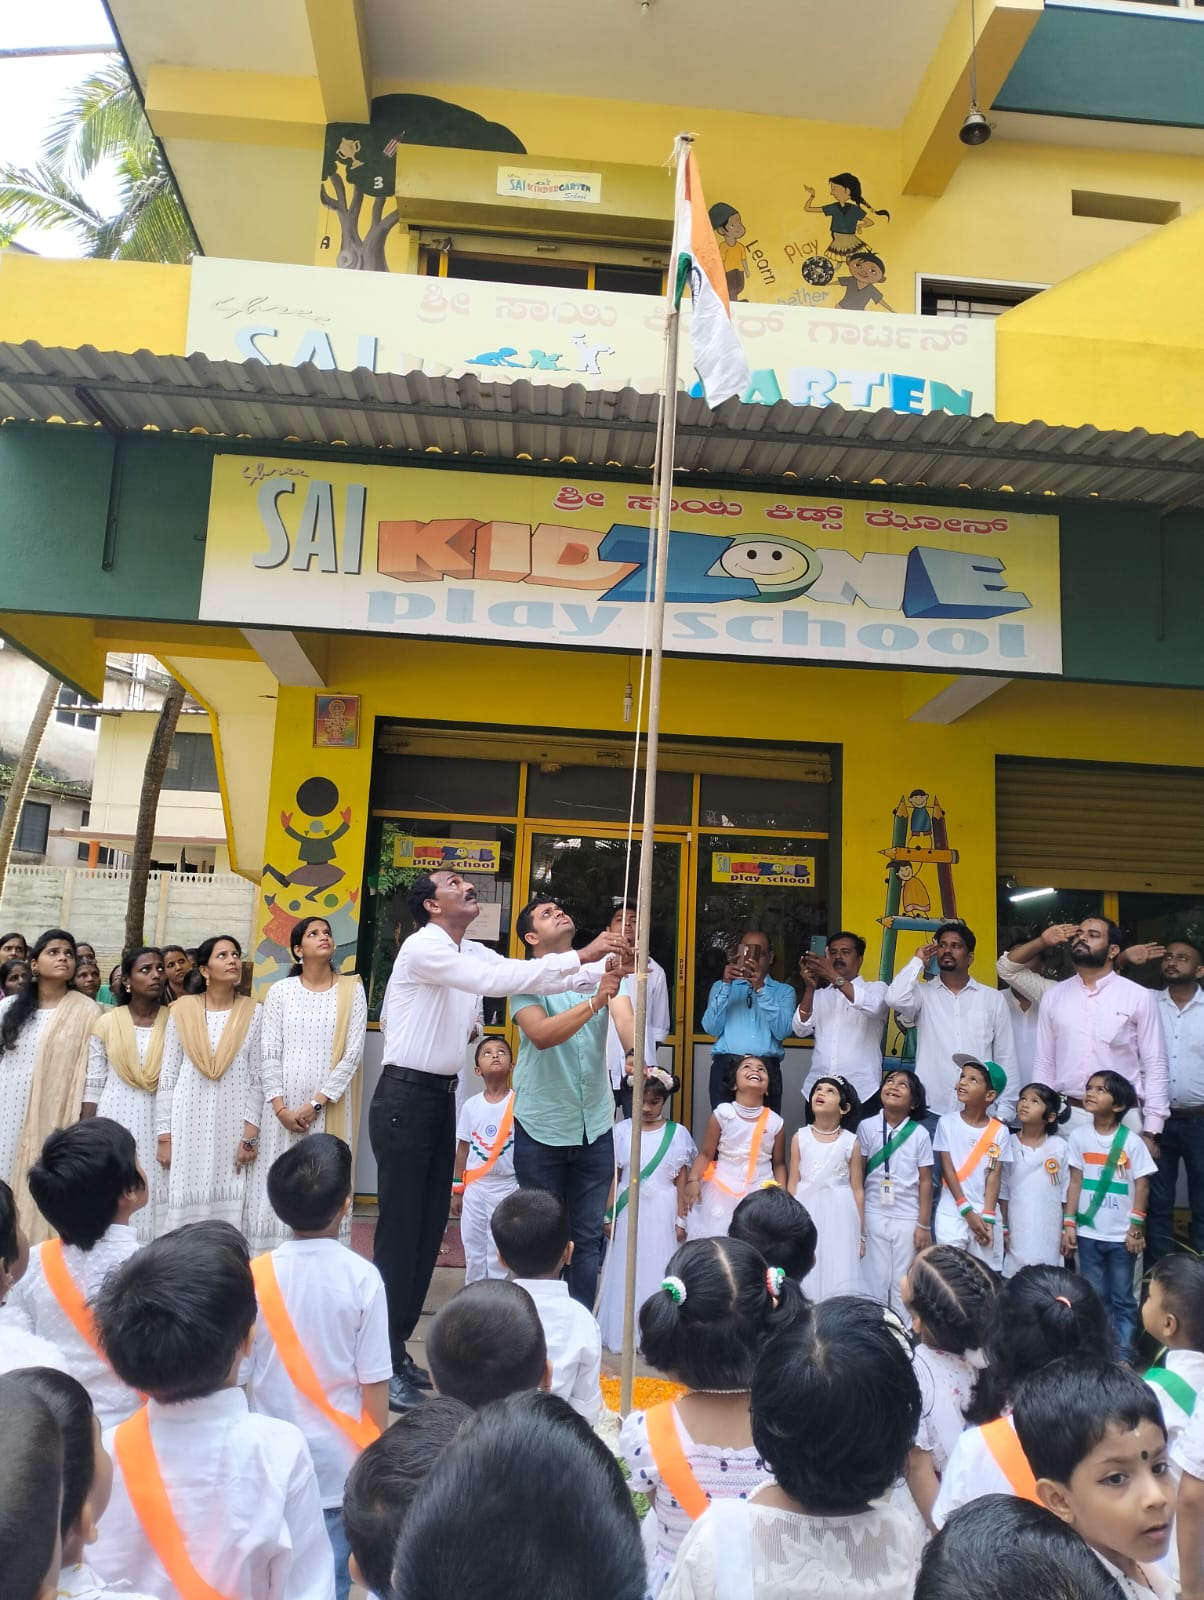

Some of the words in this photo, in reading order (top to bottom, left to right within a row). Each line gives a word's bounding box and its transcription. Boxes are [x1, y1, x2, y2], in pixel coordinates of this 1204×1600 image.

[373, 176, 384, 189] 3
[509, 179, 526, 191] SAI
[320, 235, 330, 249] A
[746, 239, 777, 285] Learn
[553, 486, 605, 511] ಶ್ರೀ
[627, 494, 743, 517] ಸಾಯಿ
[252, 478, 368, 576] SAI
[366, 588, 623, 637] play
[671, 609, 1030, 659] school
[449, 861, 496, 869] school
[730, 874, 760, 882] play
[767, 875, 810, 884] school
